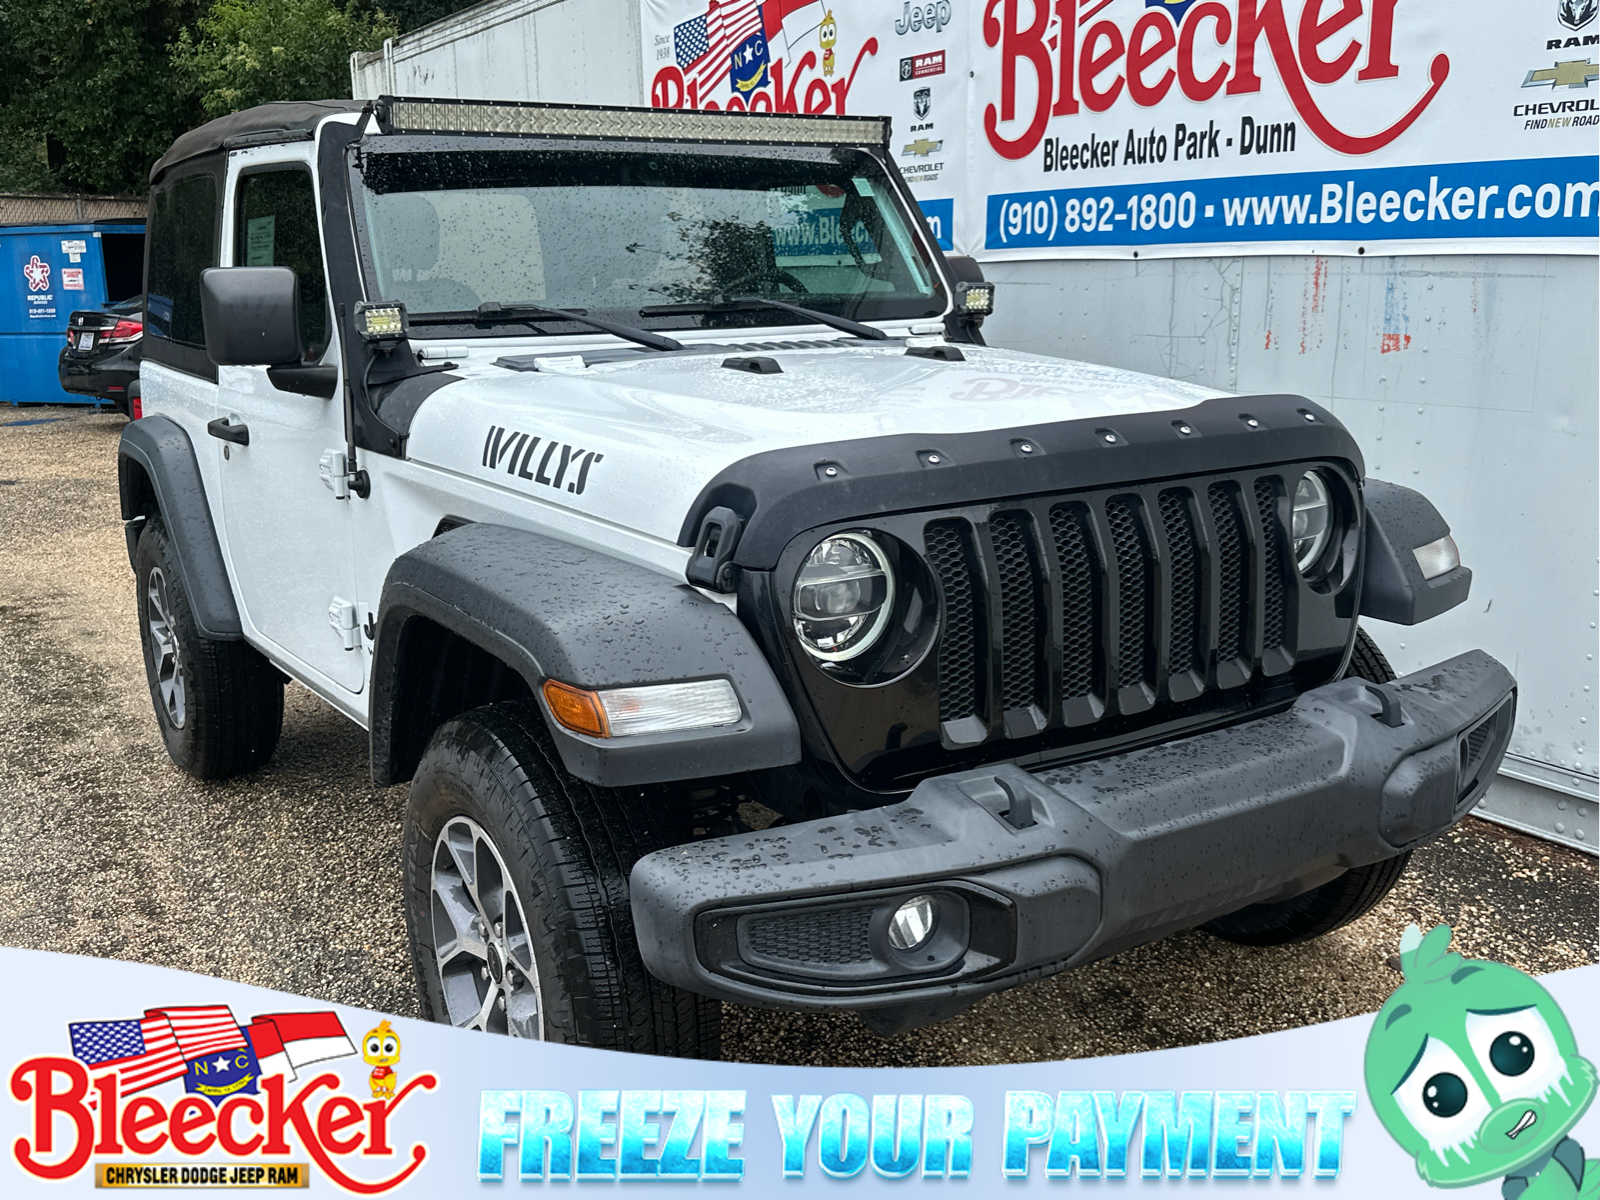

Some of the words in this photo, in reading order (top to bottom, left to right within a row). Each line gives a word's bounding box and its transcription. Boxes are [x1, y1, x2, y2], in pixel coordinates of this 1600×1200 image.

[894, 0, 952, 36] Jeep
[1546, 34, 1599, 50] RAM
[914, 54, 943, 68] RAM
[910, 122, 934, 133] RAM
[1043, 132, 1119, 173] Bleecker
[1123, 127, 1167, 166] Auto
[1173, 119, 1220, 161] Park
[1239, 115, 1297, 156] Dunn
[999, 195, 1059, 244] (910)
[1064, 190, 1197, 233] 892-1800
[1222, 175, 1599, 227] www.Bleecker.com
[482, 424, 605, 496] WILLYS
